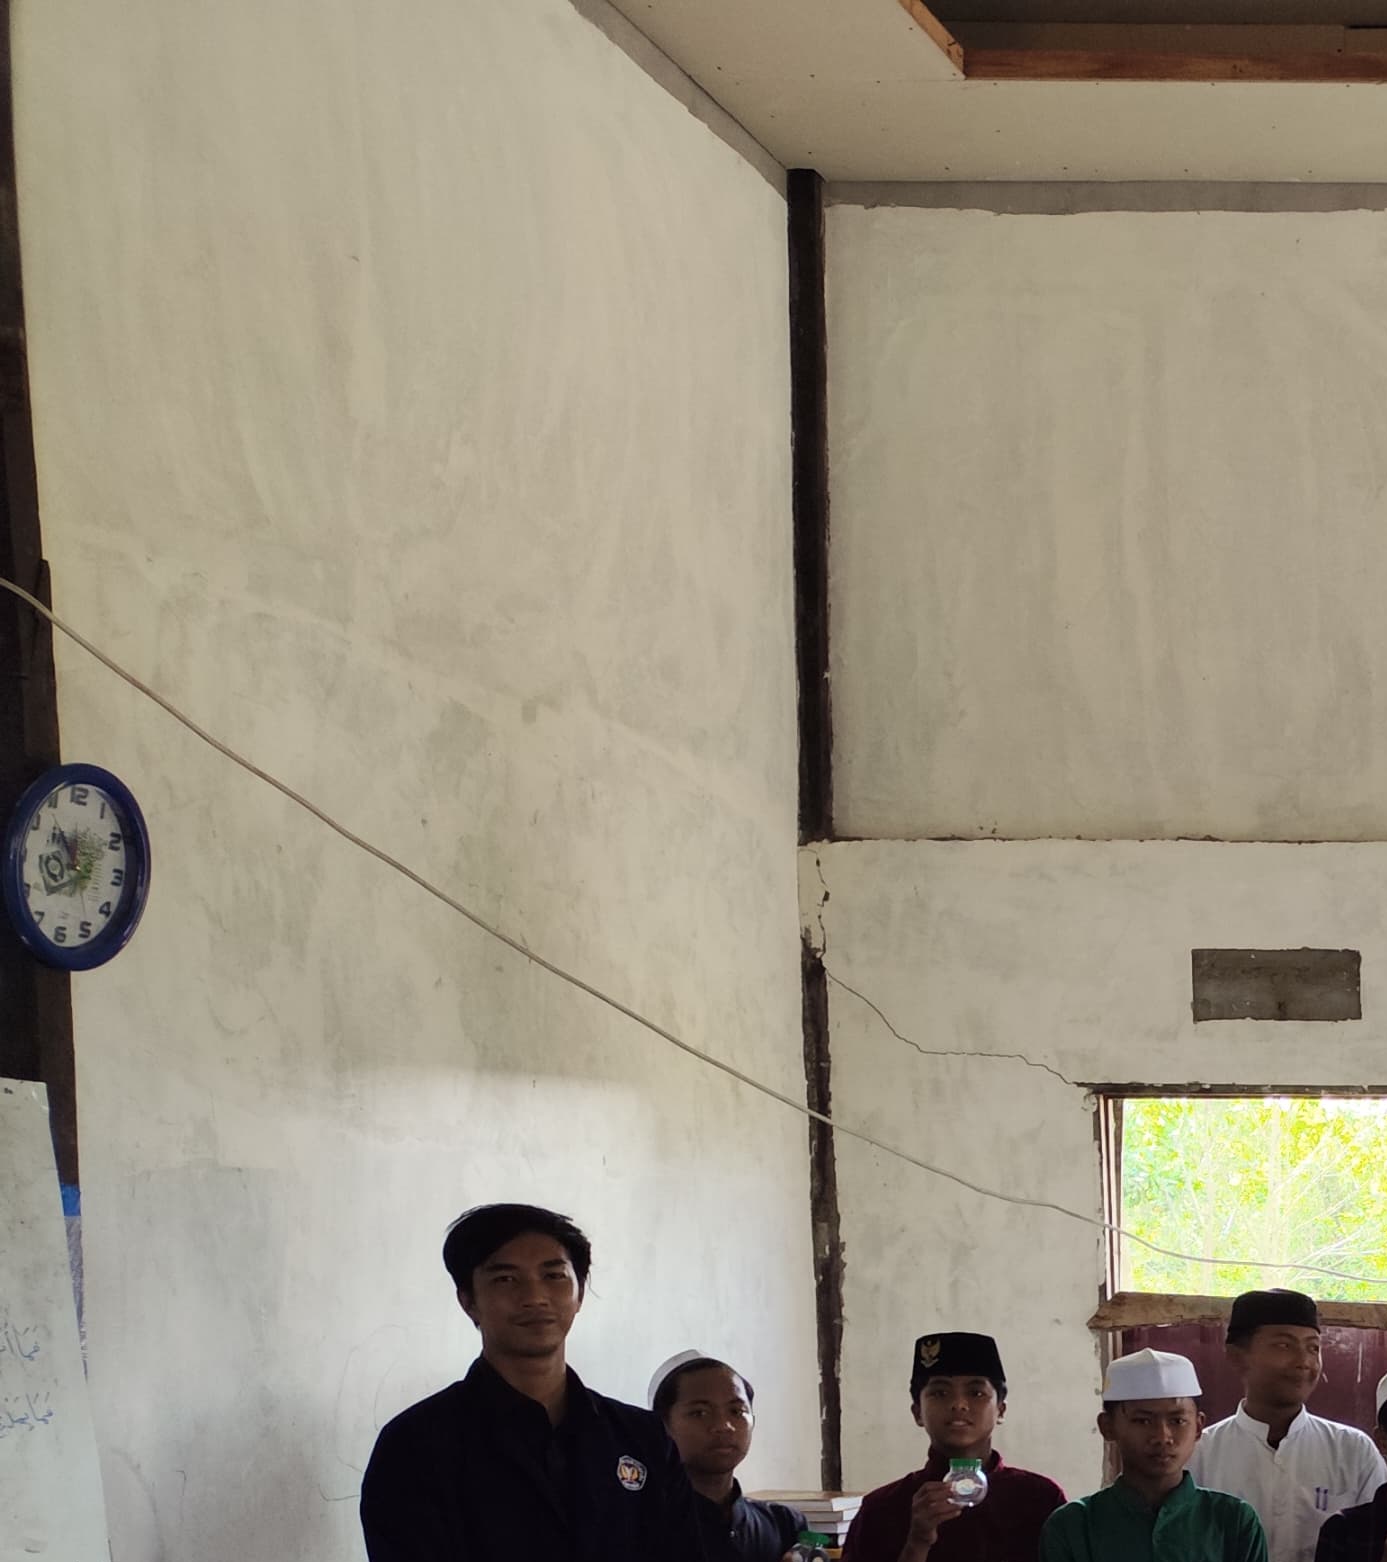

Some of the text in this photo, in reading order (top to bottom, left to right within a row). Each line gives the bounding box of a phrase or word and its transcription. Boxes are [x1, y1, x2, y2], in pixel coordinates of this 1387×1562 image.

[70, 787, 90, 806] 12
[108, 832, 122, 851] 2
[111, 868, 124, 887] 3
[98, 901, 112, 918] 4
[53, 925, 67, 944] 6
[78, 921, 92, 939] 5
